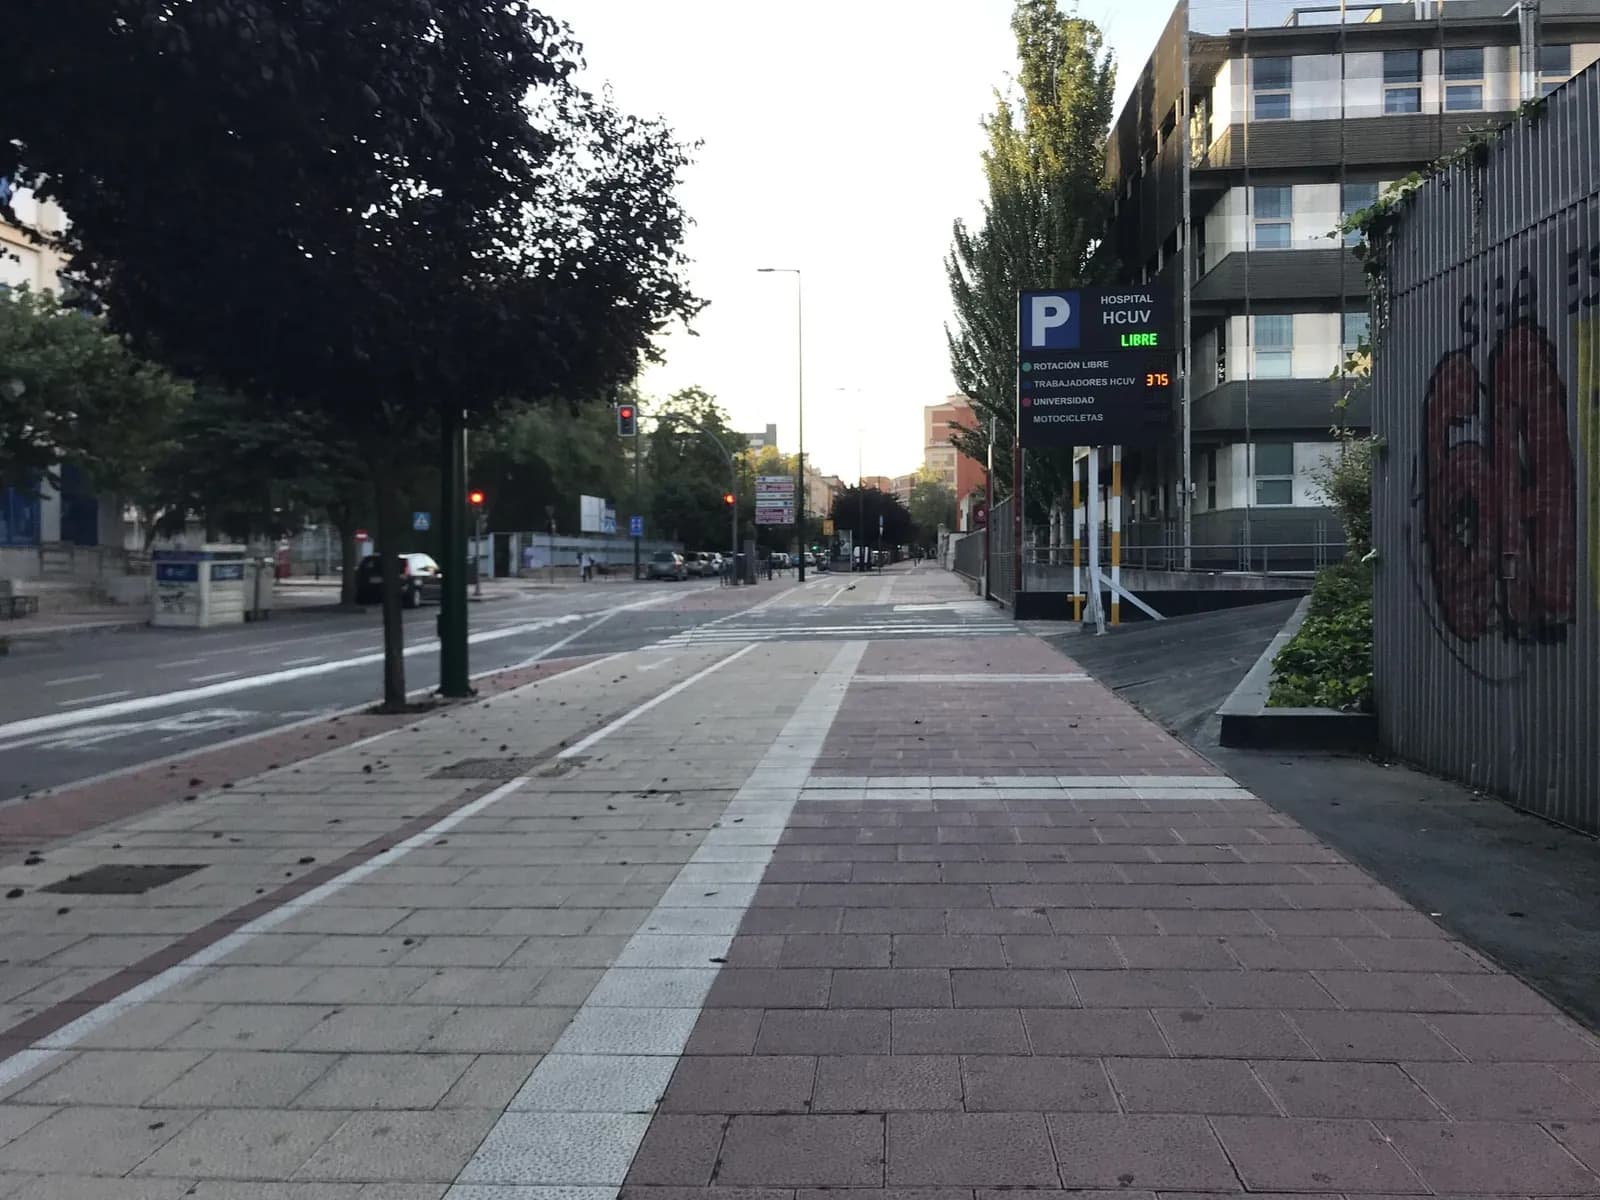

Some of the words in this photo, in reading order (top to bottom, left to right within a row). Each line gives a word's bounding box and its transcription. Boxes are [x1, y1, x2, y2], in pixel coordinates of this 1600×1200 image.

[1100, 294, 1153, 305] HOSPITAL
[1031, 296, 1071, 347] P
[1103, 310, 1151, 324] HCUV
[1120, 333, 1158, 347] LIBRE
[1033, 360, 1080, 370] ROTACIÓN
[1082, 360, 1109, 369] LIBRE
[1034, 378, 1107, 388] TRABAJADORES
[1109, 377, 1136, 386] HCUV
[1146, 373, 1169, 386] 375
[1033, 396, 1095, 406] UNIVERSIDAD
[1033, 413, 1104, 423] MOTOCICLETAS
